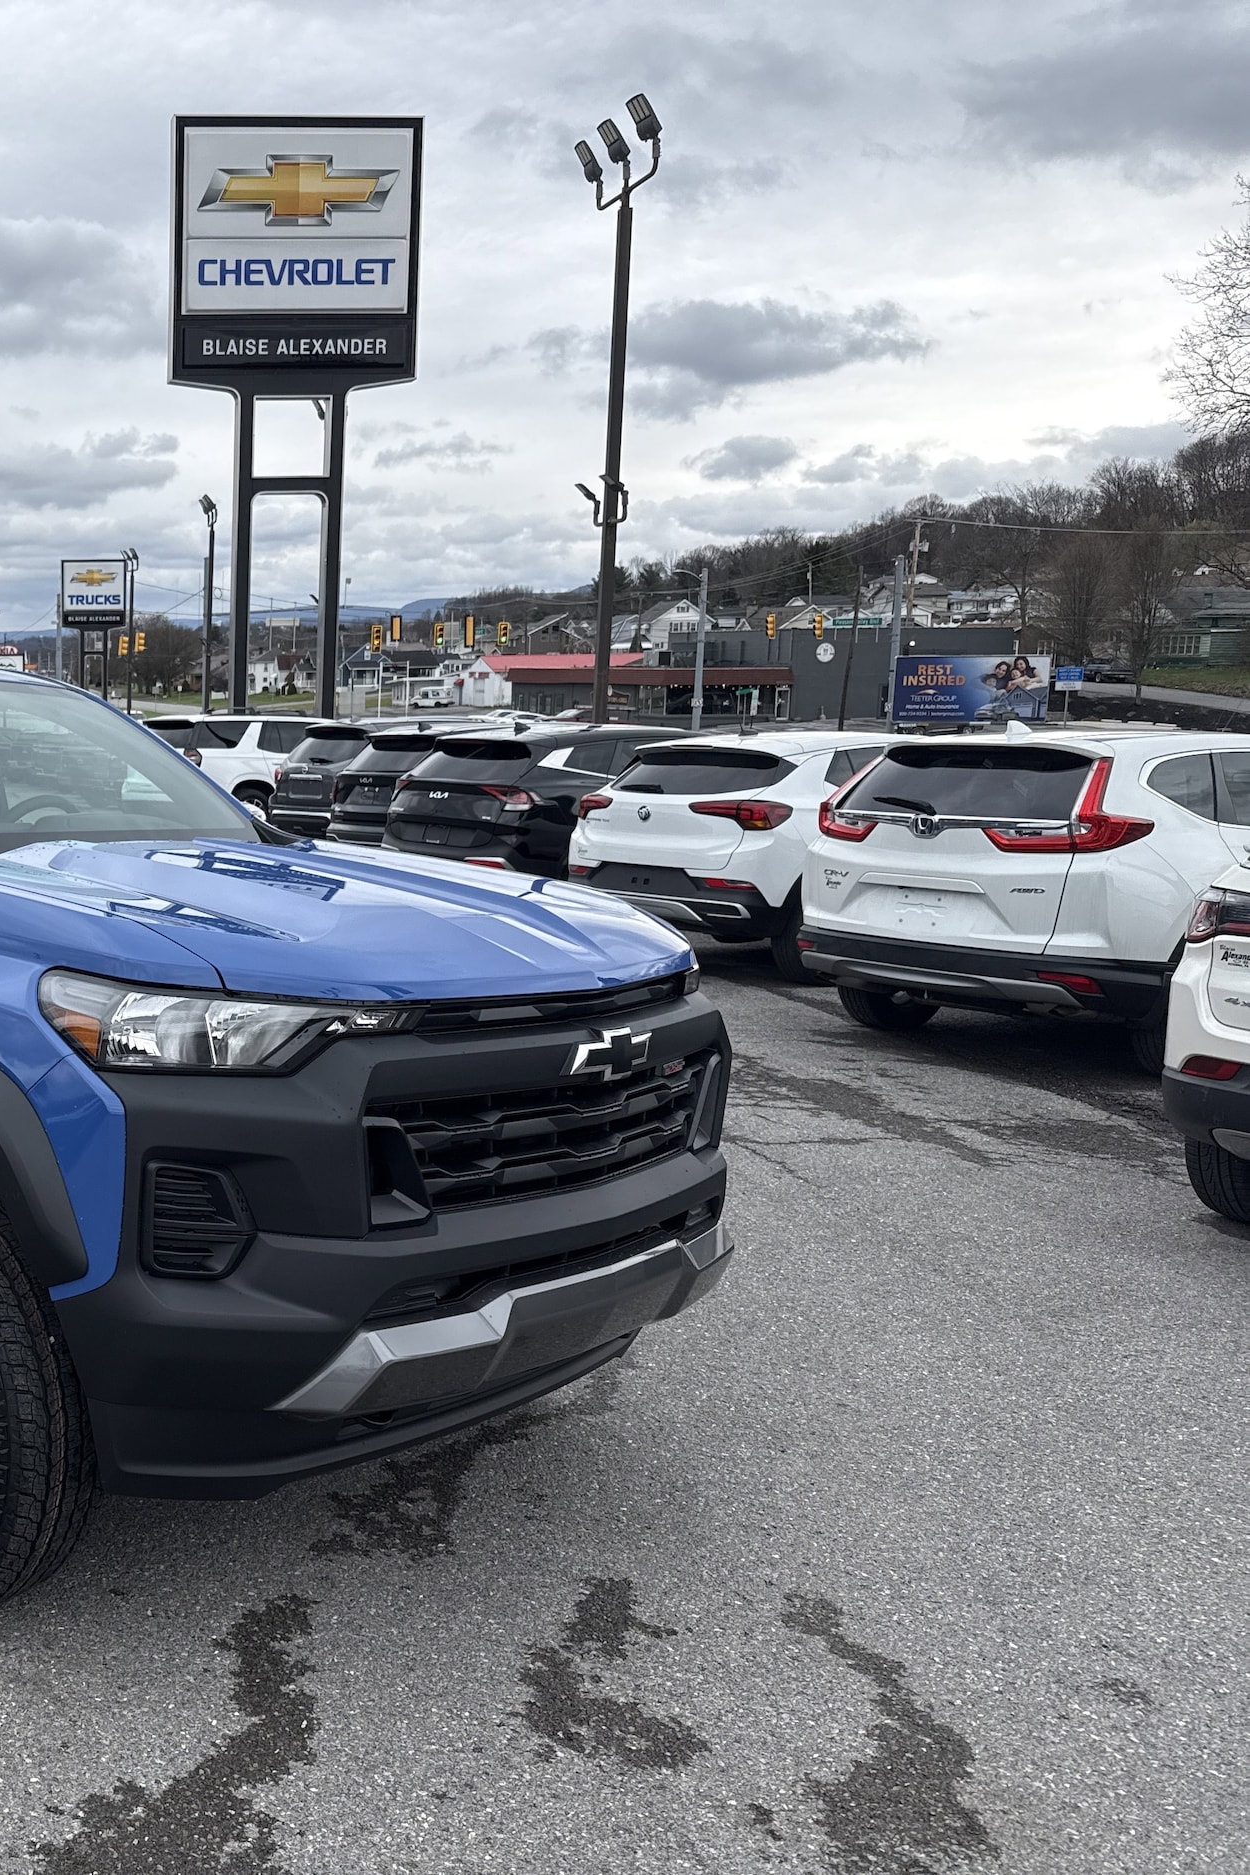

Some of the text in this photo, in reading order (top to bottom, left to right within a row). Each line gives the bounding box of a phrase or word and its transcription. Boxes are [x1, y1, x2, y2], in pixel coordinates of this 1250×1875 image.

[198, 258, 396, 286] CHEVROLET
[202, 339, 387, 356] BLAISE ALEXANDER
[67, 594, 121, 606] TRUCKS
[0, 647, 16, 655] KIA
[918, 664, 953, 676] REST
[902, 675, 966, 687] INSURED
[823, 868, 850, 878] CR-V
